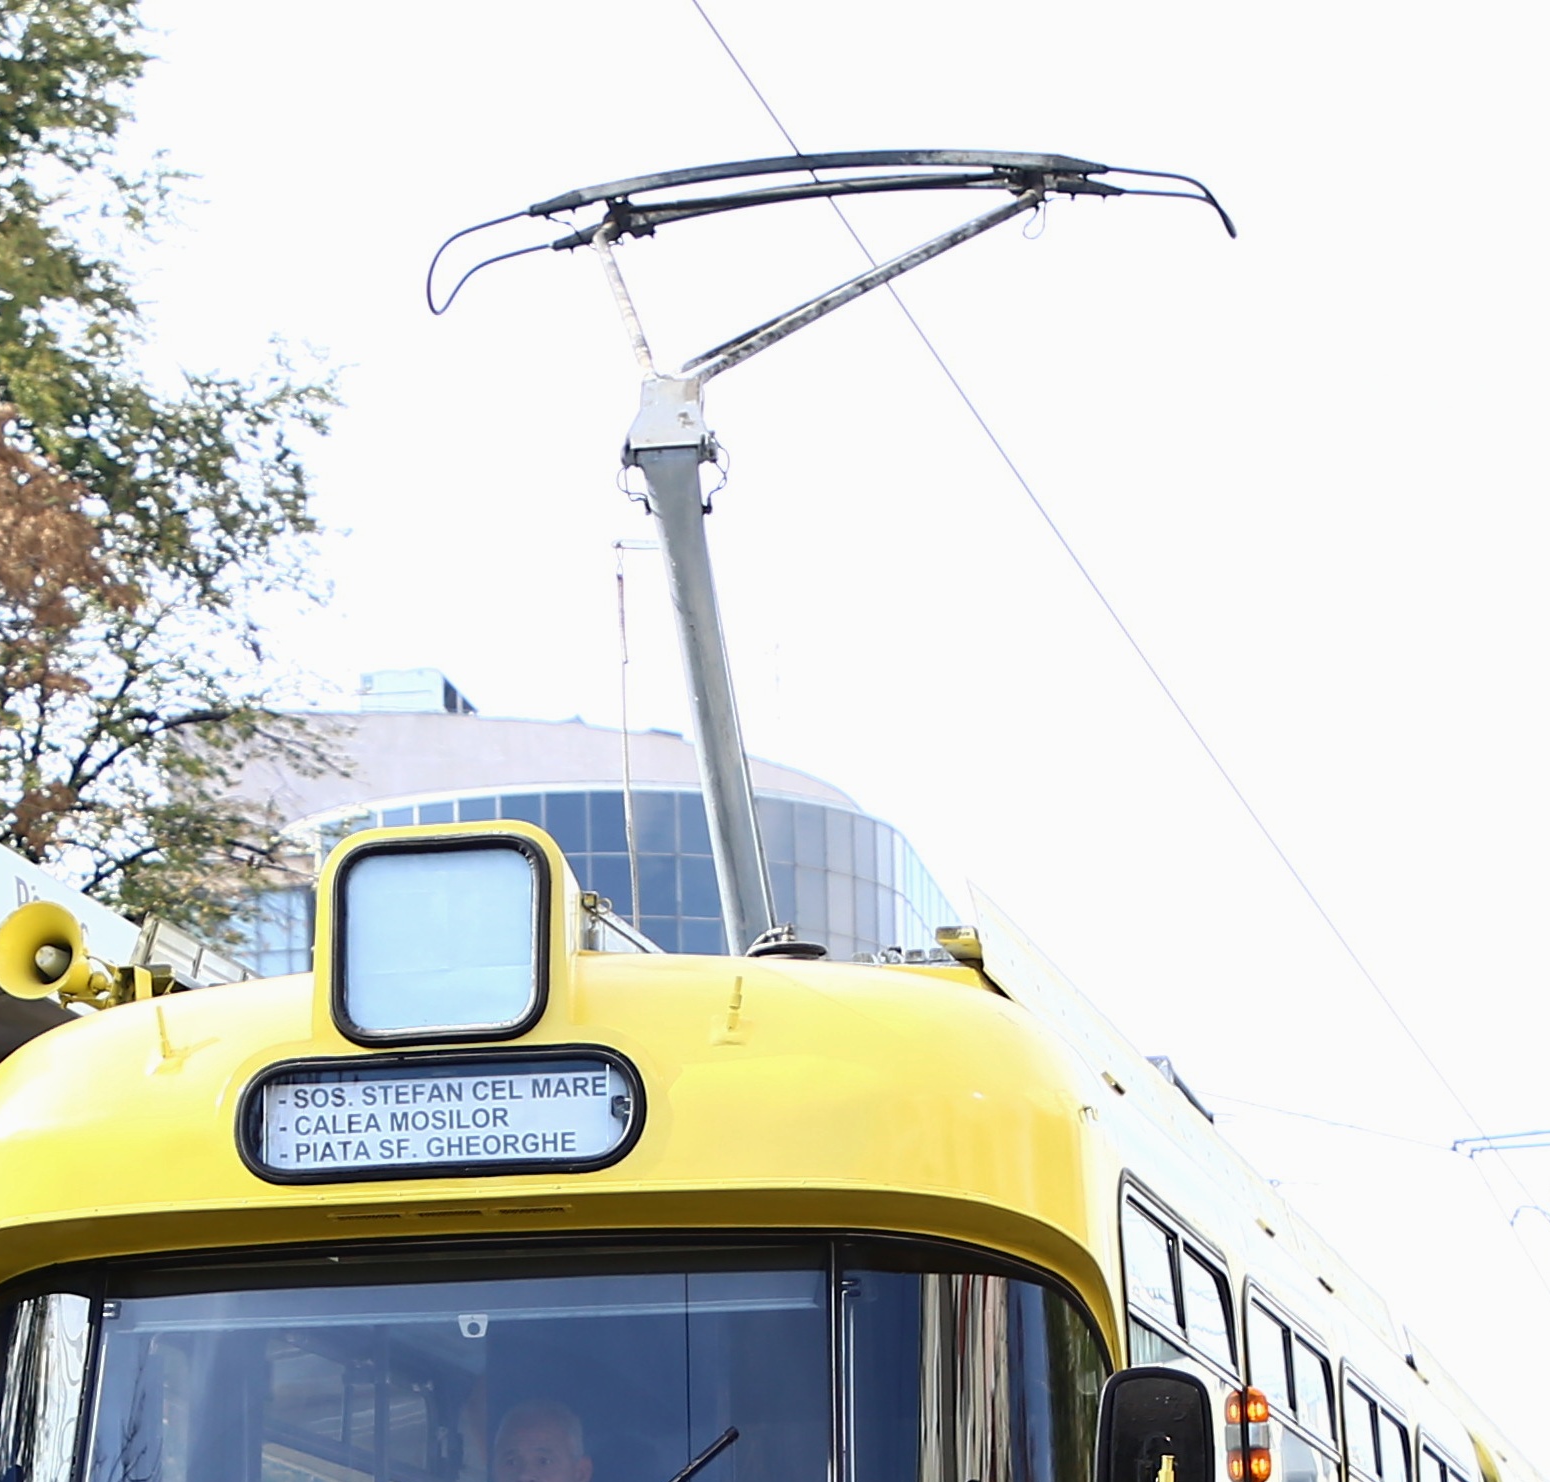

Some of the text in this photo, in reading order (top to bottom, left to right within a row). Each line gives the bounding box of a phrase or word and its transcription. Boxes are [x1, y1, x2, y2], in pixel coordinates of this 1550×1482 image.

[293, 1087, 353, 1109] SOS.
[361, 1080, 463, 1107] STEFAN
[474, 1078, 524, 1102] CEL
[531, 1075, 607, 1099] MARE
[294, 1113, 382, 1136] CALEA
[390, 1107, 509, 1132] MOSILOR
[295, 1141, 371, 1164] PIATA
[378, 1137, 417, 1160] SF.
[427, 1131, 576, 1158] GHEORGHE
